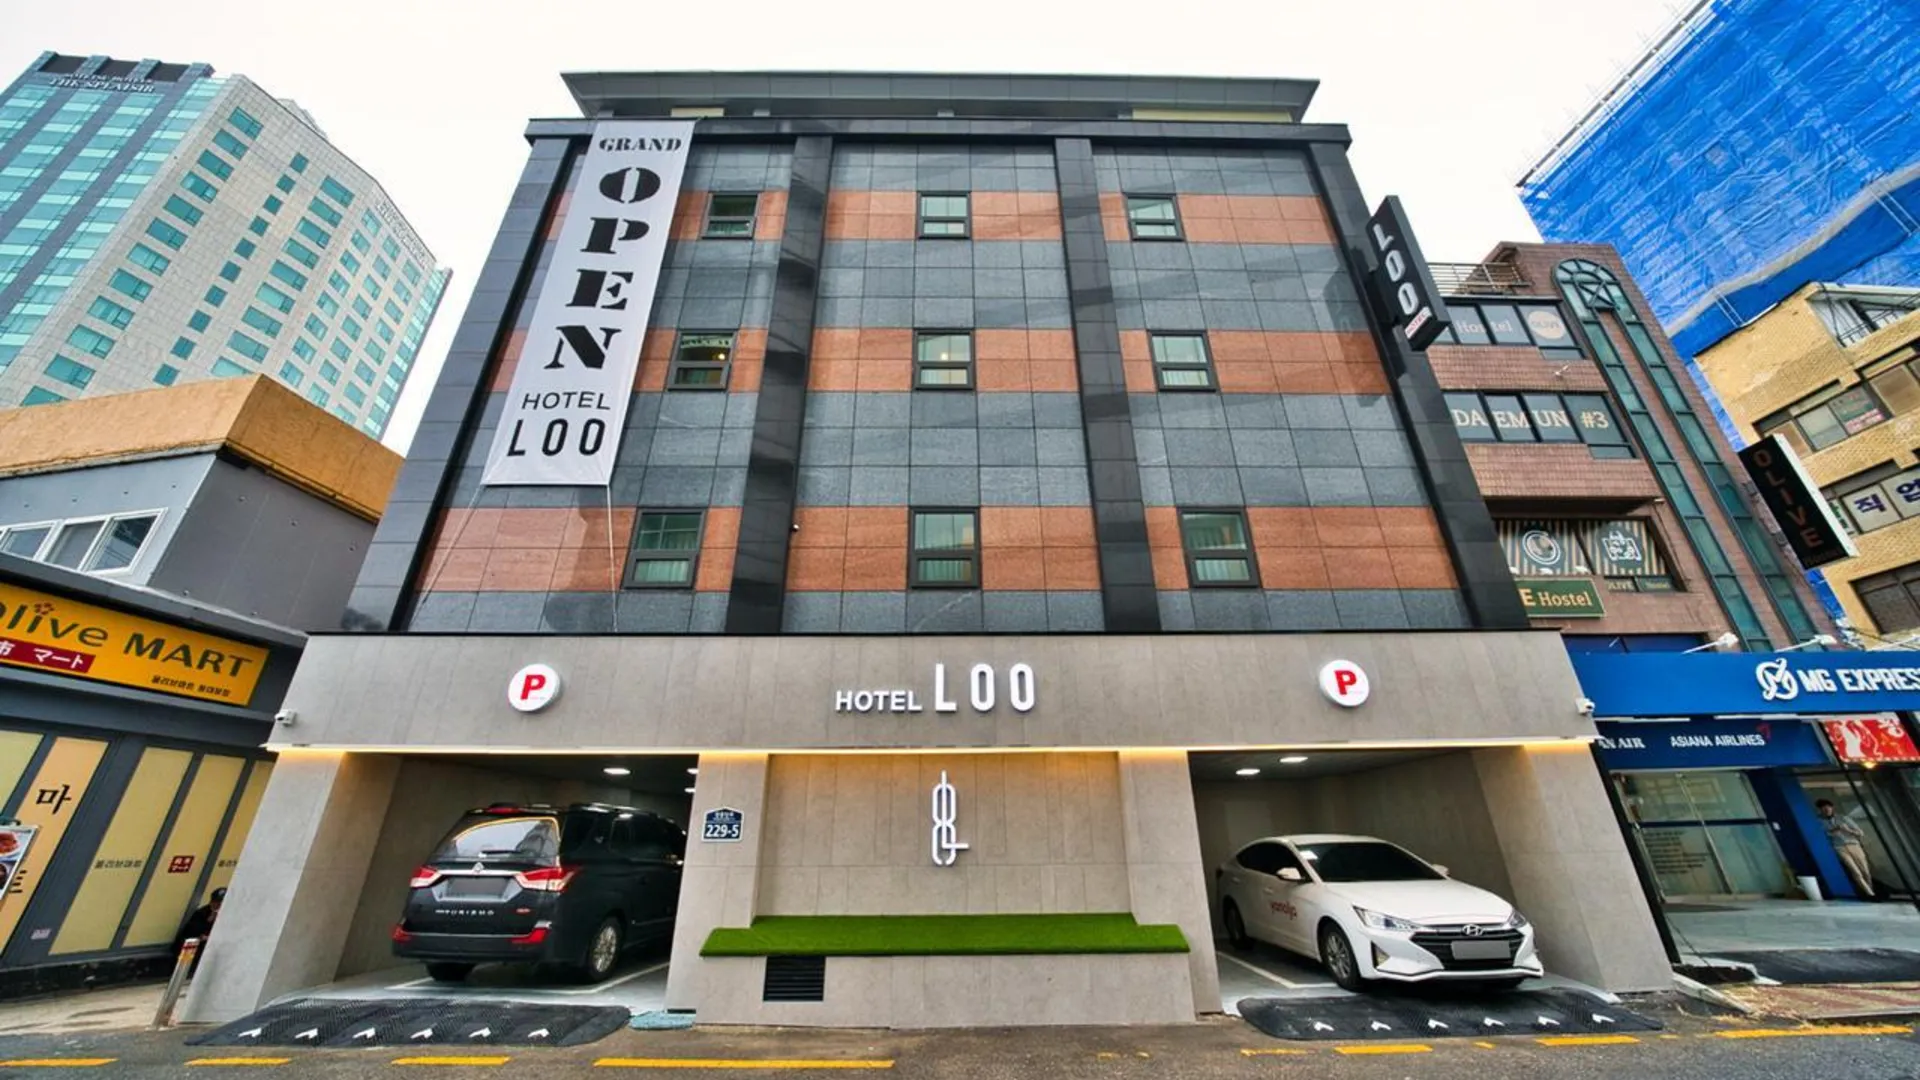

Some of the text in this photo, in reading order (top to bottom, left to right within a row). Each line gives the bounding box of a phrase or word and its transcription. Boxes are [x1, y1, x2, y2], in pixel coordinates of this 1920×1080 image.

[599, 138, 682, 152] GRAND
[543, 167, 661, 369] OPEN
[1373, 223, 1419, 316] LOO
[521, 391, 611, 410] HOTEL
[1580, 411, 1609, 429] #3
[507, 418, 606, 457] LOO
[1753, 449, 1824, 549] OLIVE
[1537, 590, 1594, 607] Hostel
[33, 647, 85, 671] マート
[123, 633, 253, 677] MART
[520, 674, 547, 700] P
[836, 663, 1035, 712] HOTEL LOO
[1333, 669, 1357, 696] P
[1796, 668, 1838, 692] MG
[1618, 737, 1646, 749] AIR
[1670, 734, 1765, 748] ASIANA AIRLINES
[705, 823, 740, 838] 229-5
